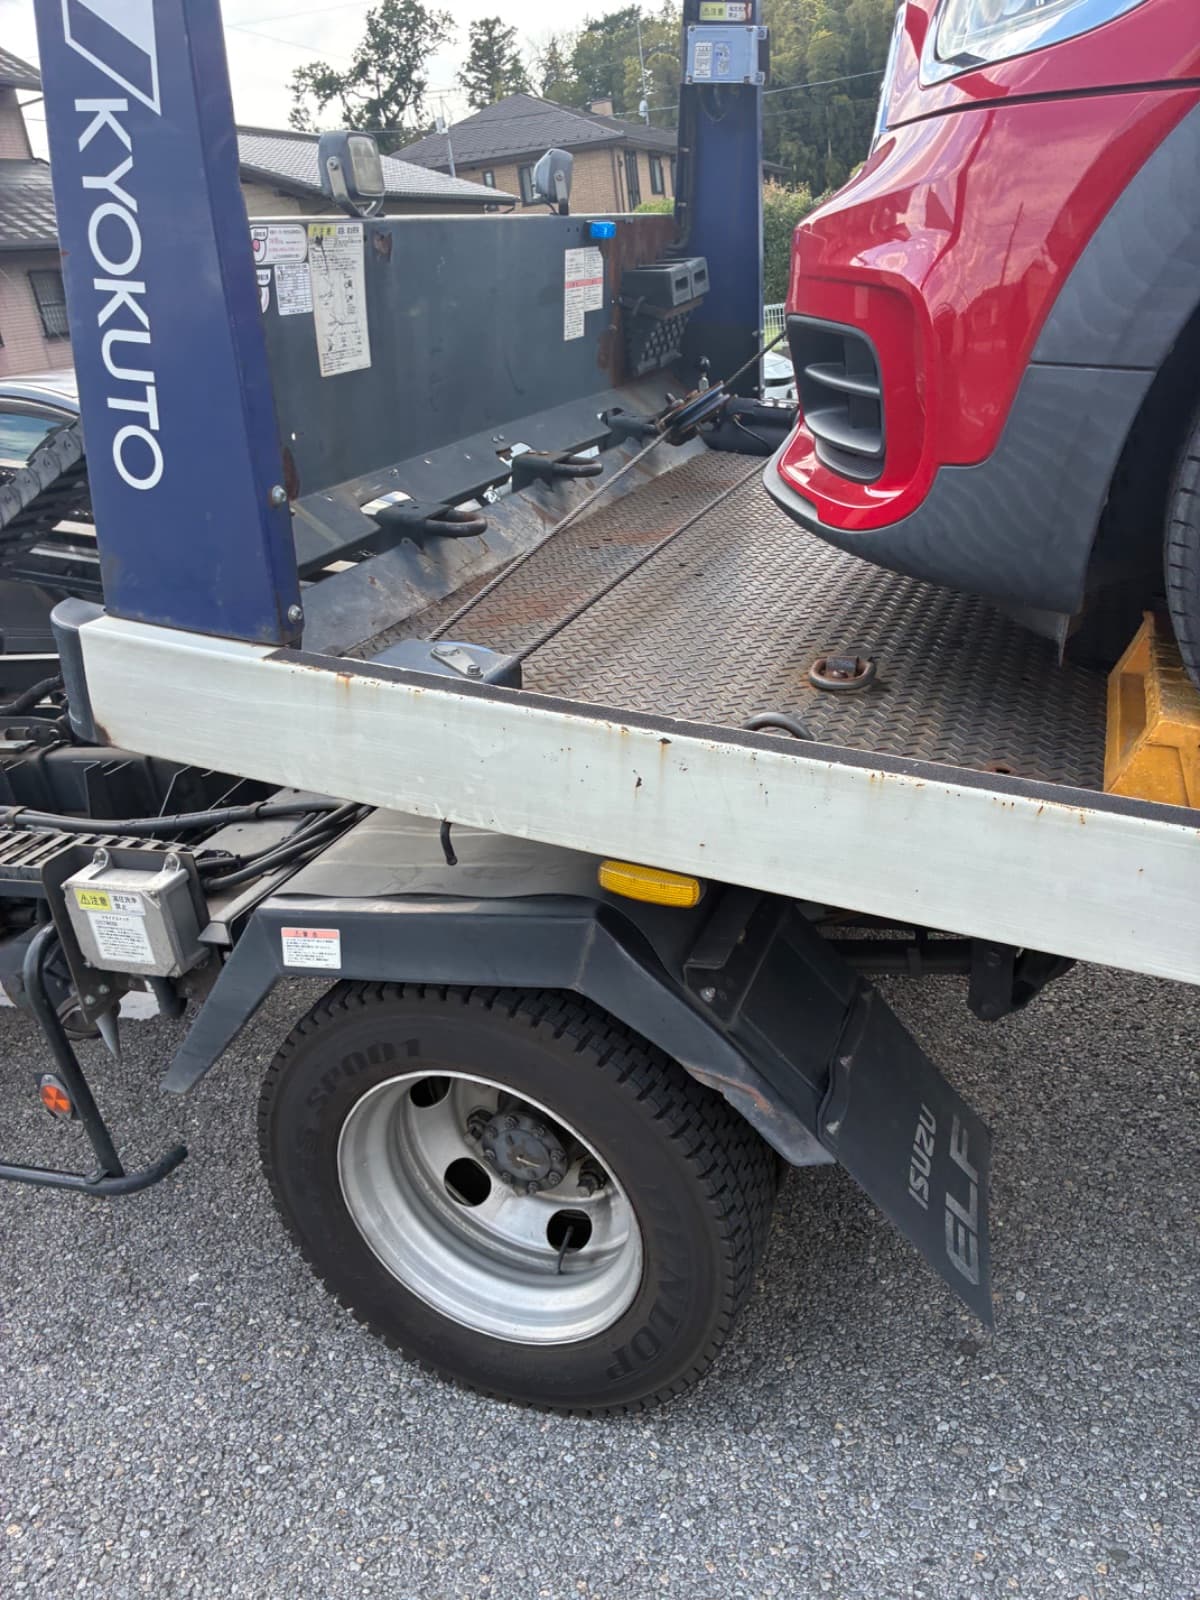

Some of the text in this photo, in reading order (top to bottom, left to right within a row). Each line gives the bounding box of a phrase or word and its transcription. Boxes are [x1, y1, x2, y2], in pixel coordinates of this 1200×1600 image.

[74, 98, 164, 490] KYOKUTO
[908, 1103, 937, 1211] ISUZU
[945, 1114, 980, 1286] ELF
